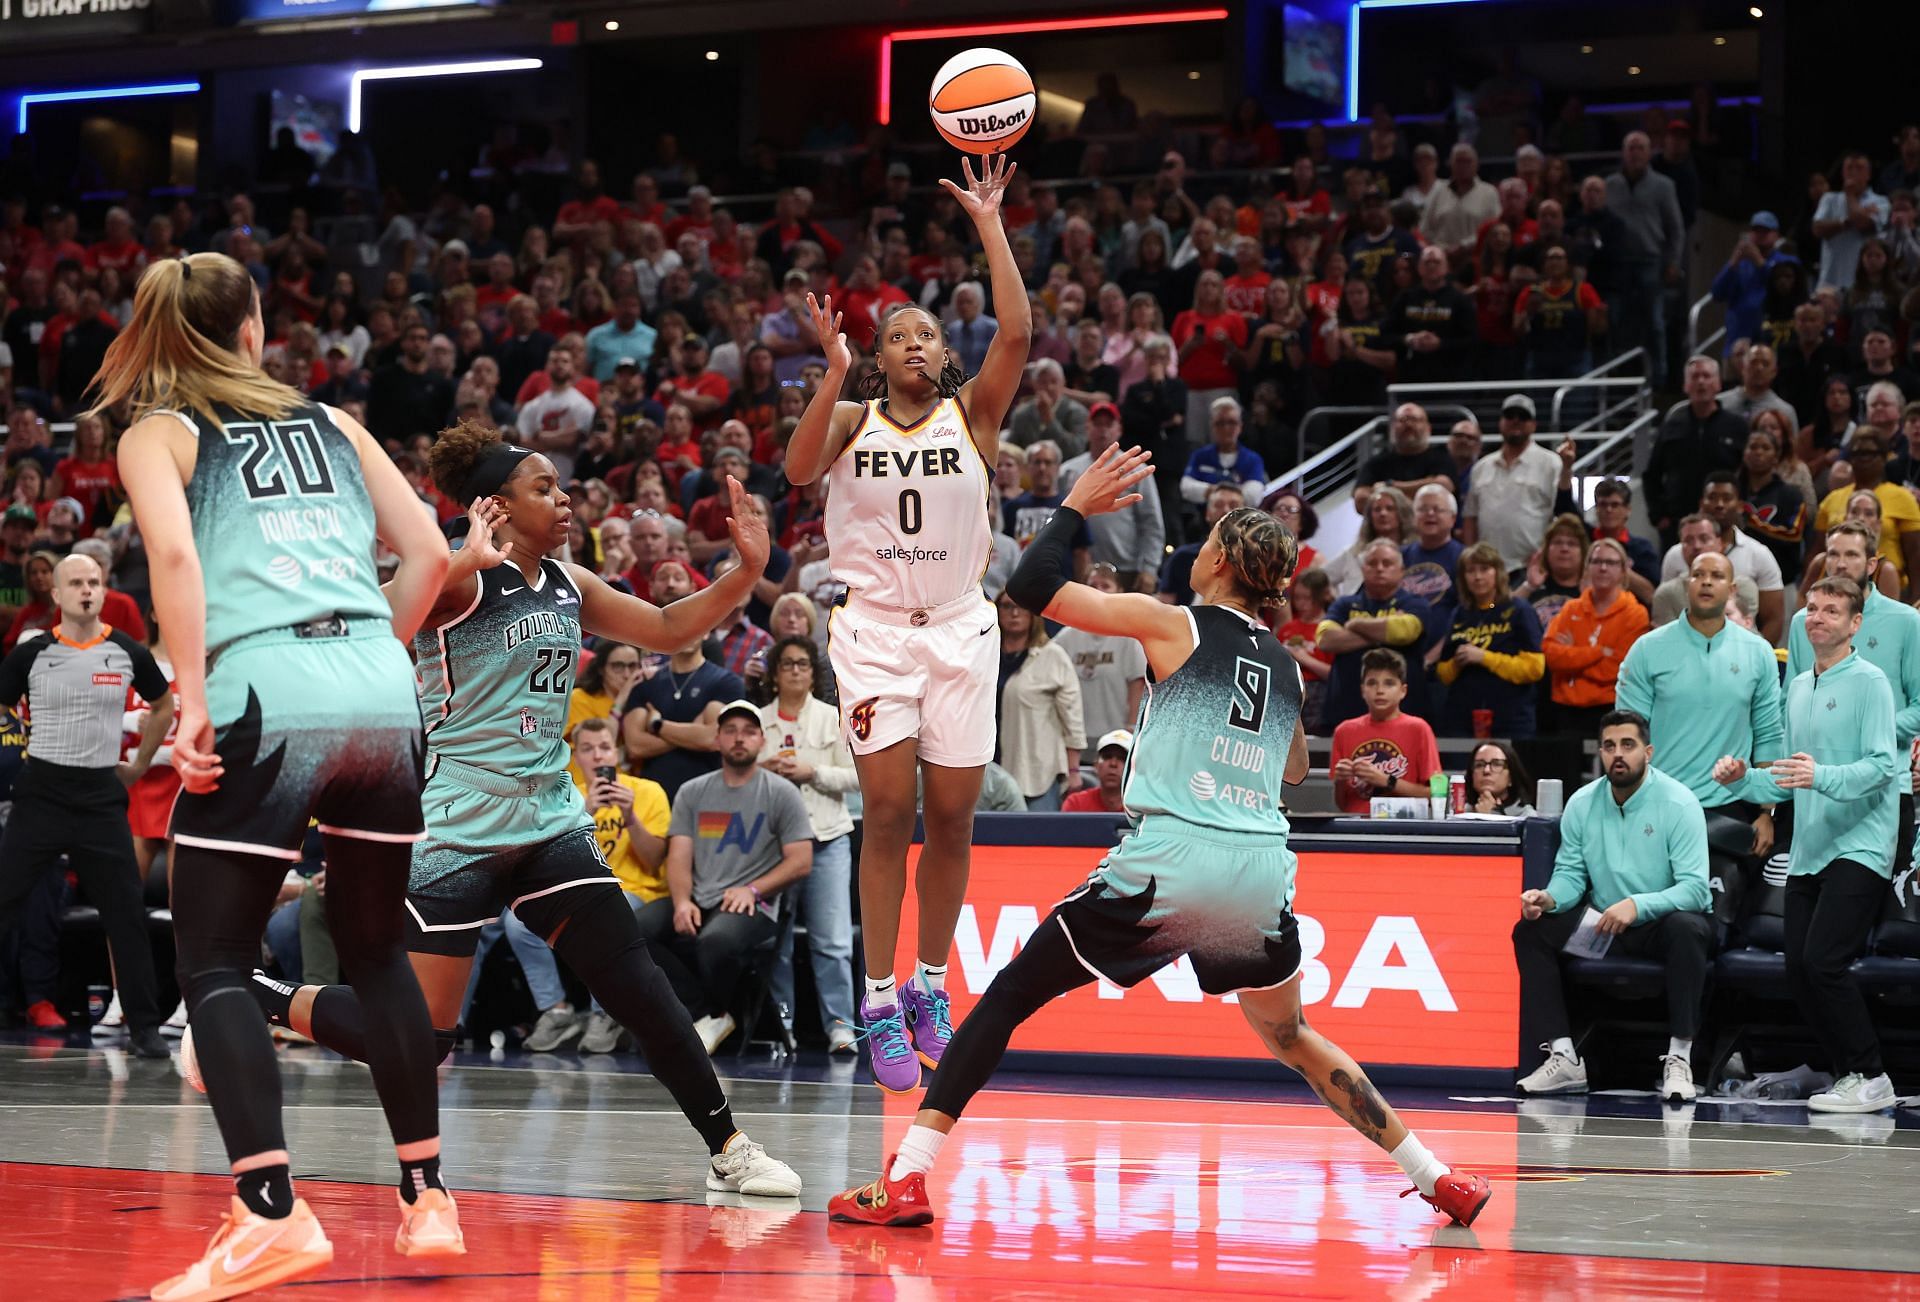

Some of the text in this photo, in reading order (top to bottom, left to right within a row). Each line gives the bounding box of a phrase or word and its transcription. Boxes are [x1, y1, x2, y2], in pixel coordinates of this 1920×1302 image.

[957, 109, 1026, 135] Wilson
[932, 426, 957, 438] Lilly
[222, 418, 339, 503] 20
[854, 447, 964, 478] FEVER
[257, 506, 345, 545] IONESCU
[898, 488, 922, 535] 0
[876, 545, 947, 565] salesforce
[528, 648, 573, 695] 22
[1227, 655, 1271, 735] 9
[1210, 735, 1265, 774] CLOUD
[1219, 783, 1268, 811] AT&T
